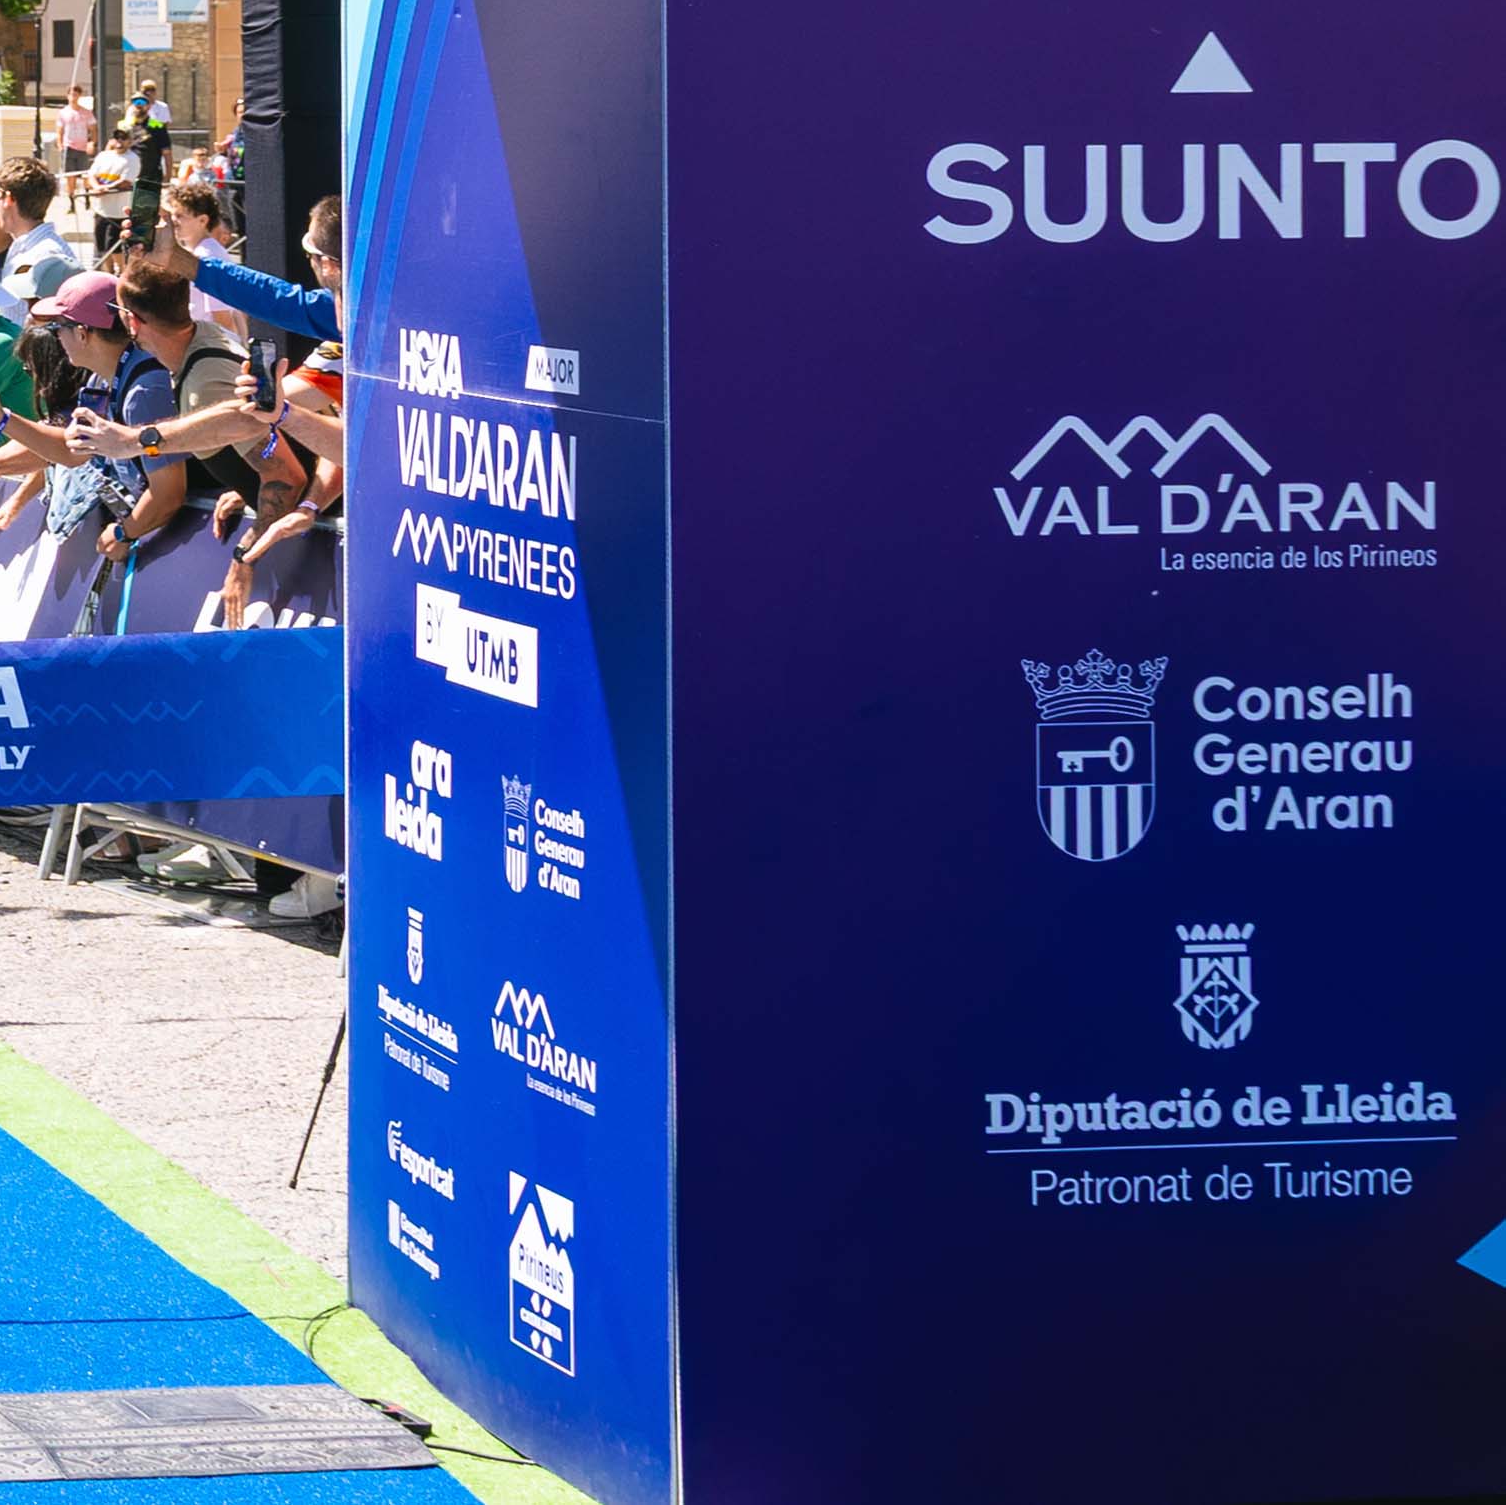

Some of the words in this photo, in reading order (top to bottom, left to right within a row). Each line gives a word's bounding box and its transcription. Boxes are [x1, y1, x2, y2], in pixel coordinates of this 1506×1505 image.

[923, 139, 1501, 244] SUUNTO
[397, 328, 464, 399] HOKA
[535, 357, 574, 384] MAJOR
[994, 486, 1139, 536] VAL
[1161, 473, 1436, 534] D'ARAN
[453, 523, 575, 600] PYRENEES
[1160, 548, 1185, 571] La
[1192, 547, 1273, 571] esencia
[1281, 546, 1306, 569] de
[1314, 545, 1342, 568] los
[1349, 544, 1437, 567] Pirineos
[426, 603, 444, 646] BY
[466, 625, 519, 684] UTMB
[1193, 673, 1413, 722] Conselh
[411, 739, 452, 798] ara
[1193, 732, 1413, 776] Generau
[384, 774, 443, 861] lleida
[1212, 786, 1393, 832] d'Aran
[491, 1017, 524, 1062] VAL
[526, 1032, 596, 1093] D'ARAN
[985, 1089, 1221, 1144] Diputació
[1232, 1086, 1292, 1127] de
[1301, 1082, 1456, 1125] Lleida
[1031, 1167, 1191, 1206] Patronat
[1205, 1164, 1253, 1201] de
[1264, 1161, 1413, 1199] Turisme
[518, 1243, 564, 1294] Pirineus
